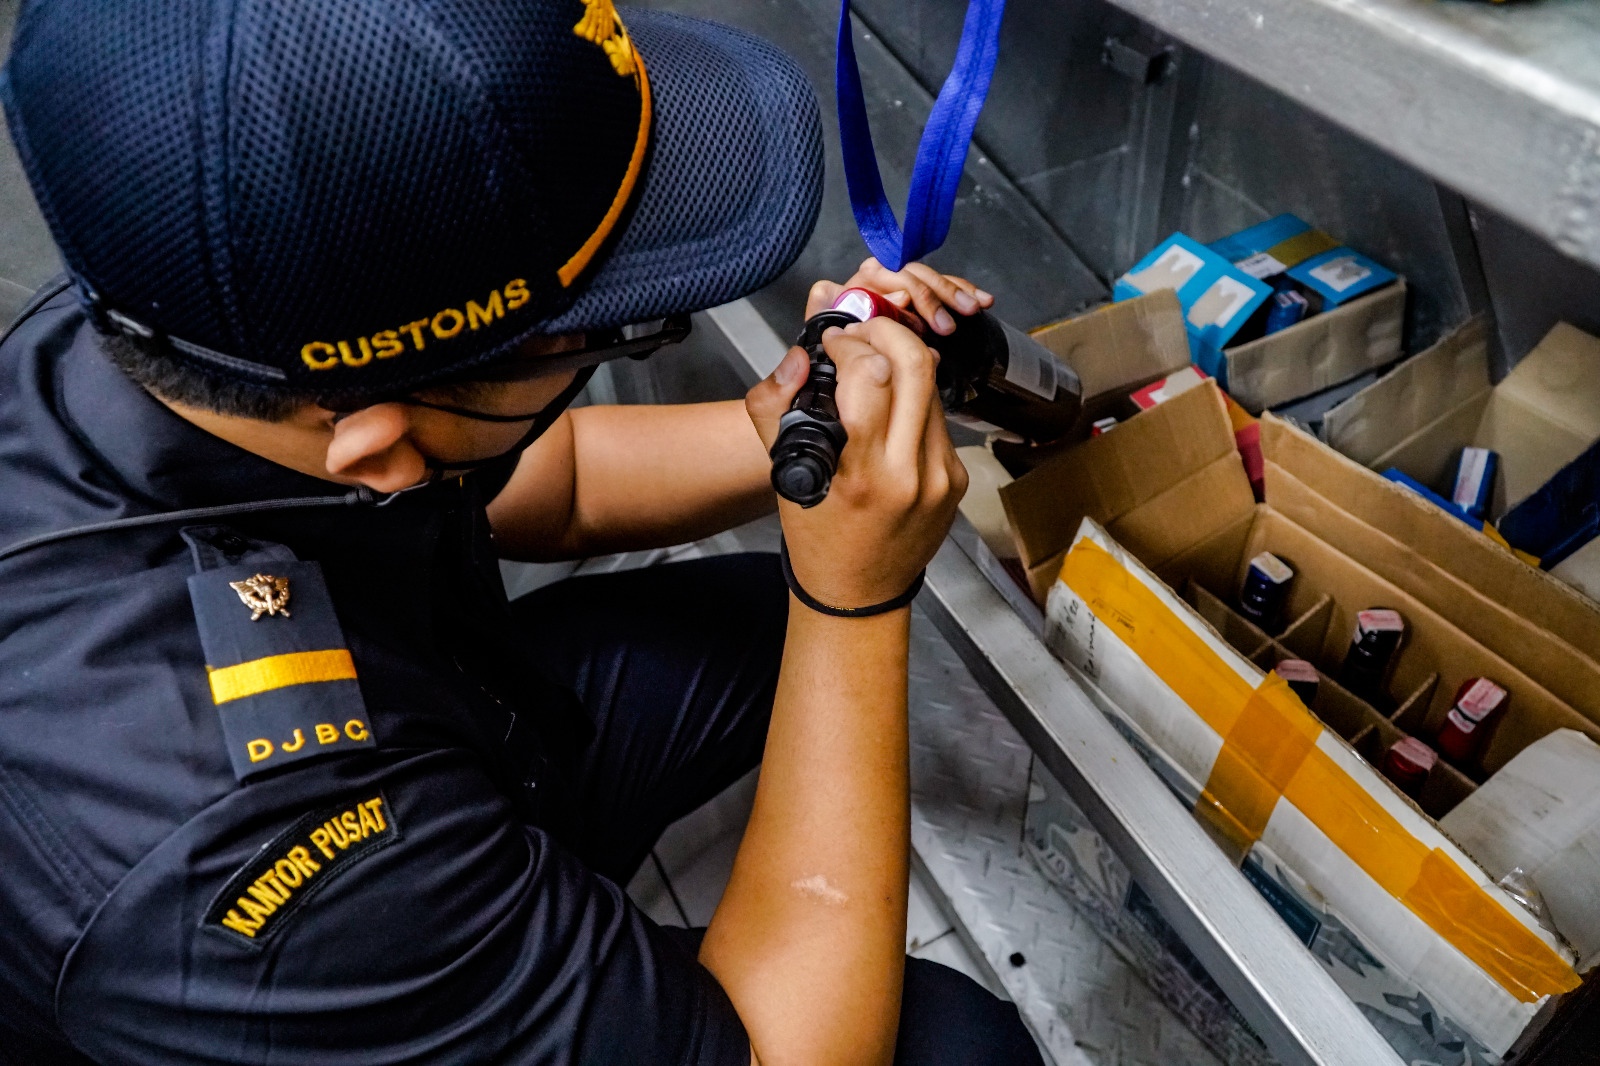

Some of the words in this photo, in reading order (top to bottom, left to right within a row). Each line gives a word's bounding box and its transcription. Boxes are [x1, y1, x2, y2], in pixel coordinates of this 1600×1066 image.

[300, 279, 530, 371] CUSTOMS
[222, 845, 321, 938] KANTOR
[309, 797, 387, 860] PUSAT
